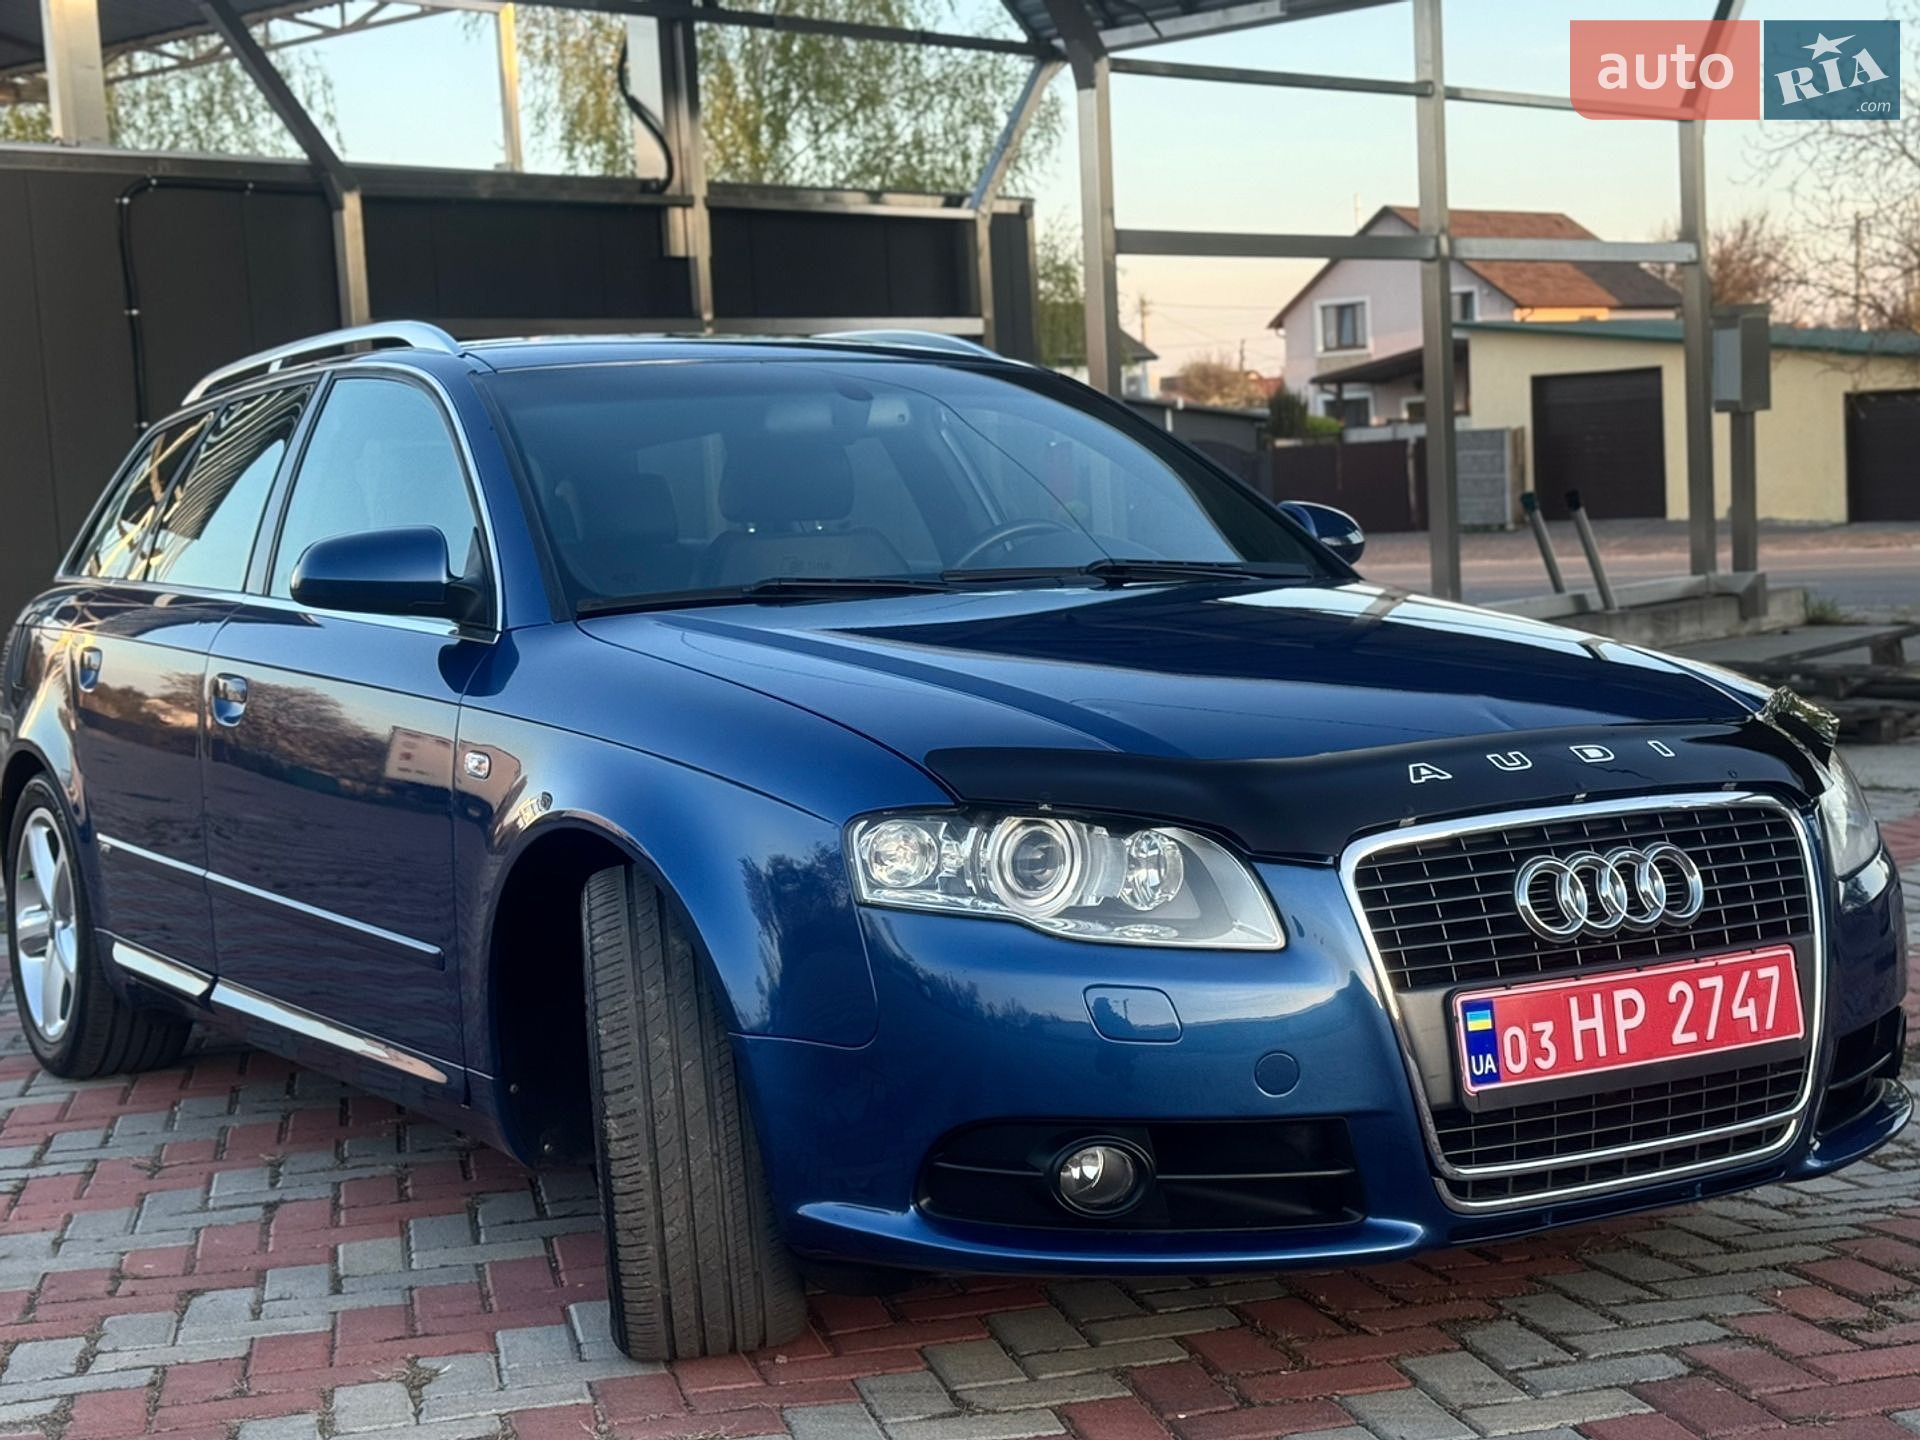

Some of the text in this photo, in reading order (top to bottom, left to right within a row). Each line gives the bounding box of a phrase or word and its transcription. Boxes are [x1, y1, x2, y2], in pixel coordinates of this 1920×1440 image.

[1502, 966, 1780, 1074] 03 HP 2747
[1471, 1053, 1497, 1076] UA
